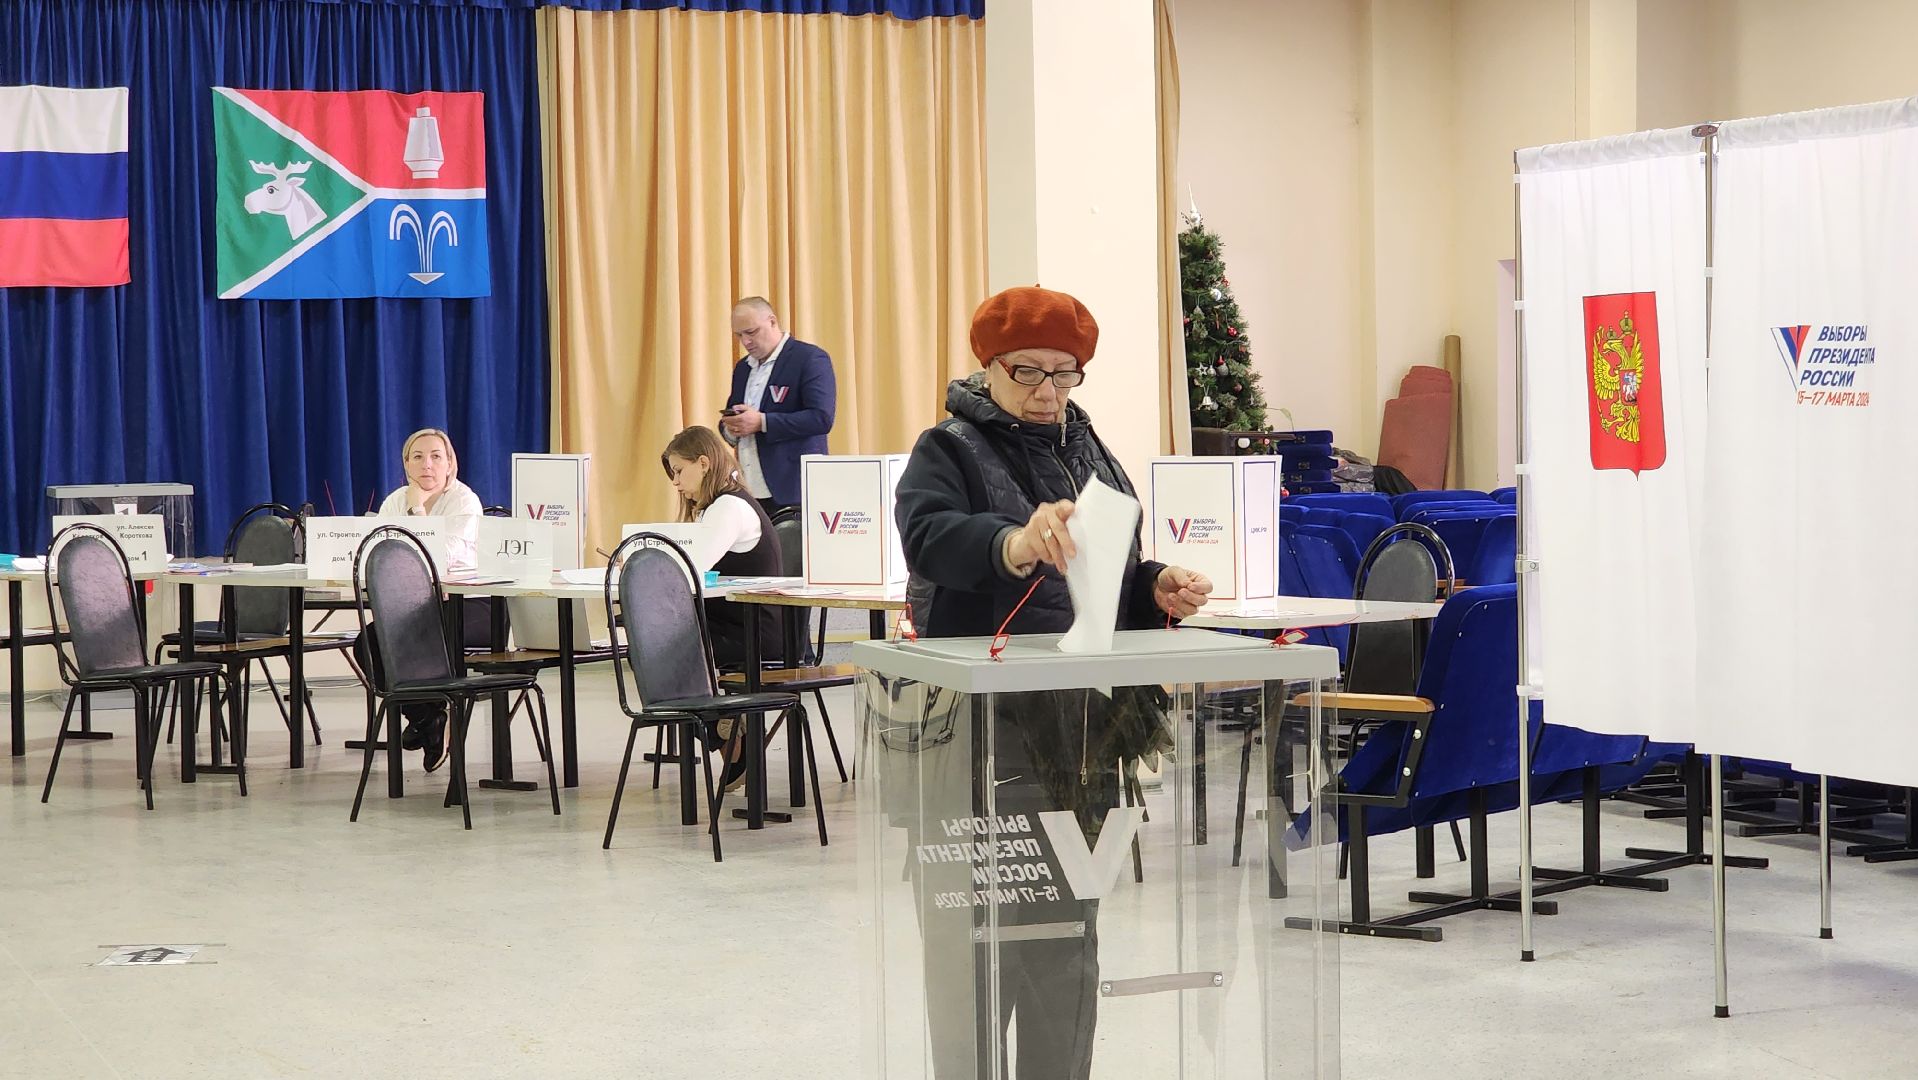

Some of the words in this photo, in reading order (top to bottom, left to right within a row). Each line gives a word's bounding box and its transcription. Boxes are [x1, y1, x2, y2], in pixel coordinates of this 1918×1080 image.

[1817, 325, 1868, 342] ВЫБОРЫ
[1808, 347, 1875, 366] ПРЕЗИДЕНТА
[1800, 369, 1855, 387] РОССИИ
[1824, 391, 1856, 406] МАРТА
[1855, 391, 1870, 407] 2024
[317, 532, 328, 540] ул.
[141, 550, 148, 561] 1
[347, 550, 353, 561] 1
[496, 539, 534, 558] ДЭГ
